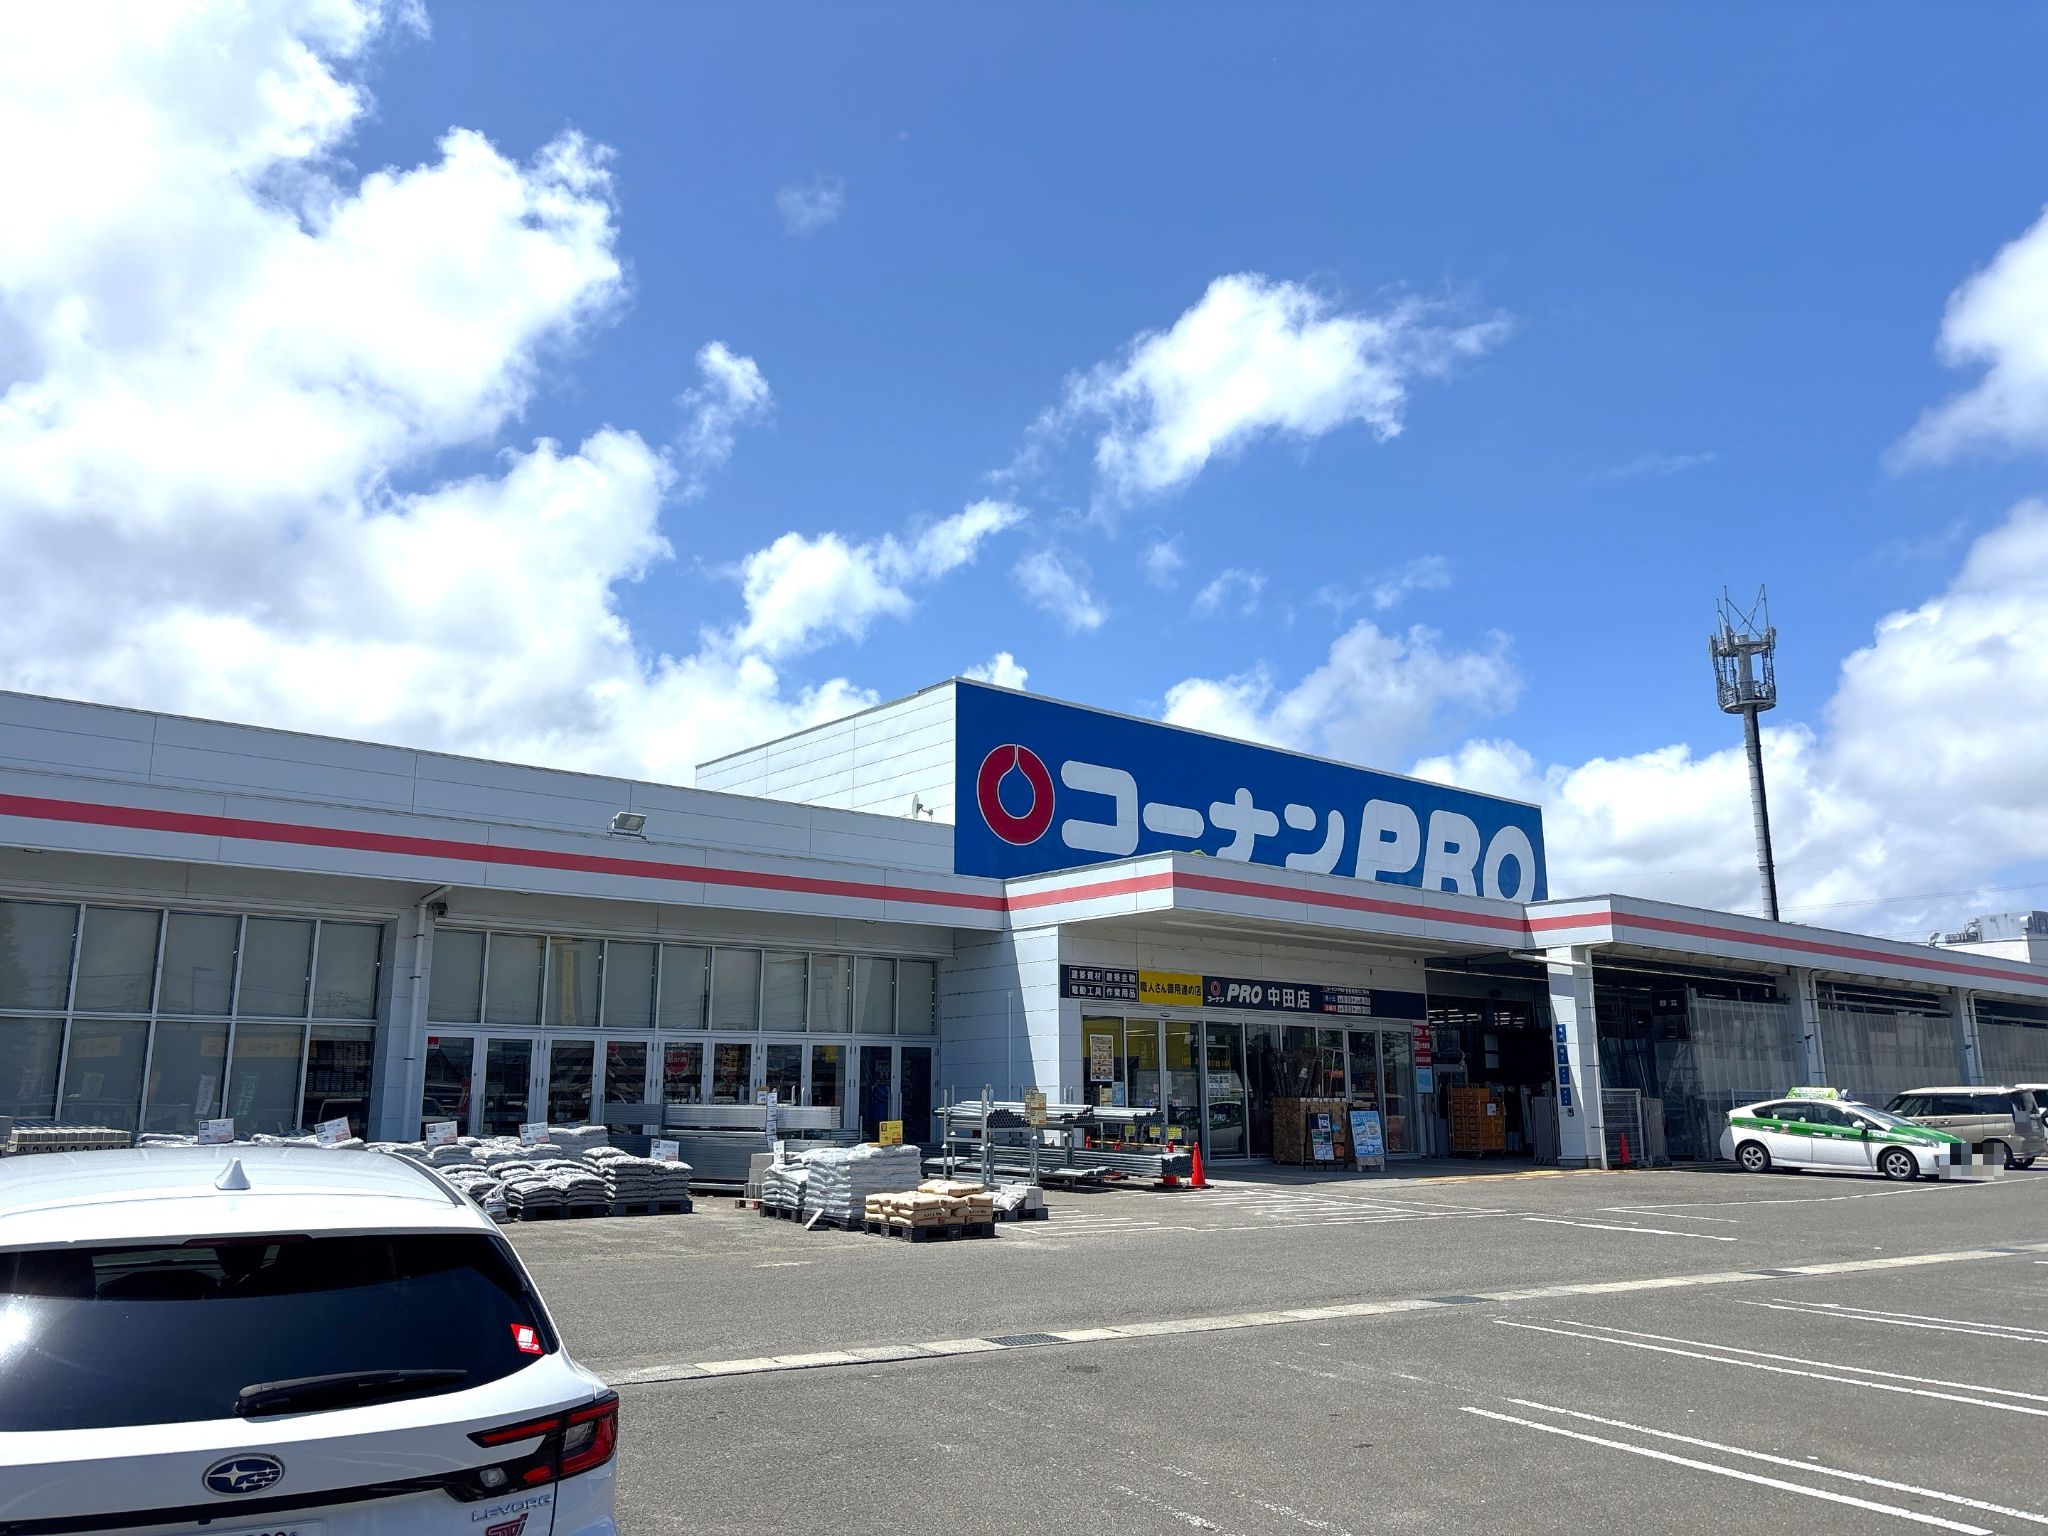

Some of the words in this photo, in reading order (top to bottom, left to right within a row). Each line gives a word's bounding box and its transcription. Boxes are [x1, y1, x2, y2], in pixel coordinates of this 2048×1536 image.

[1071, 985, 1102, 997] 電動工具
[1106, 988, 1136, 999] 作業用品
[1227, 983, 1262, 1004] PRO
[1267, 986, 1310, 1009] 中田店
[1207, 995, 1225, 1003] コーナン
[472, 1494, 551, 1522] LEVORG
